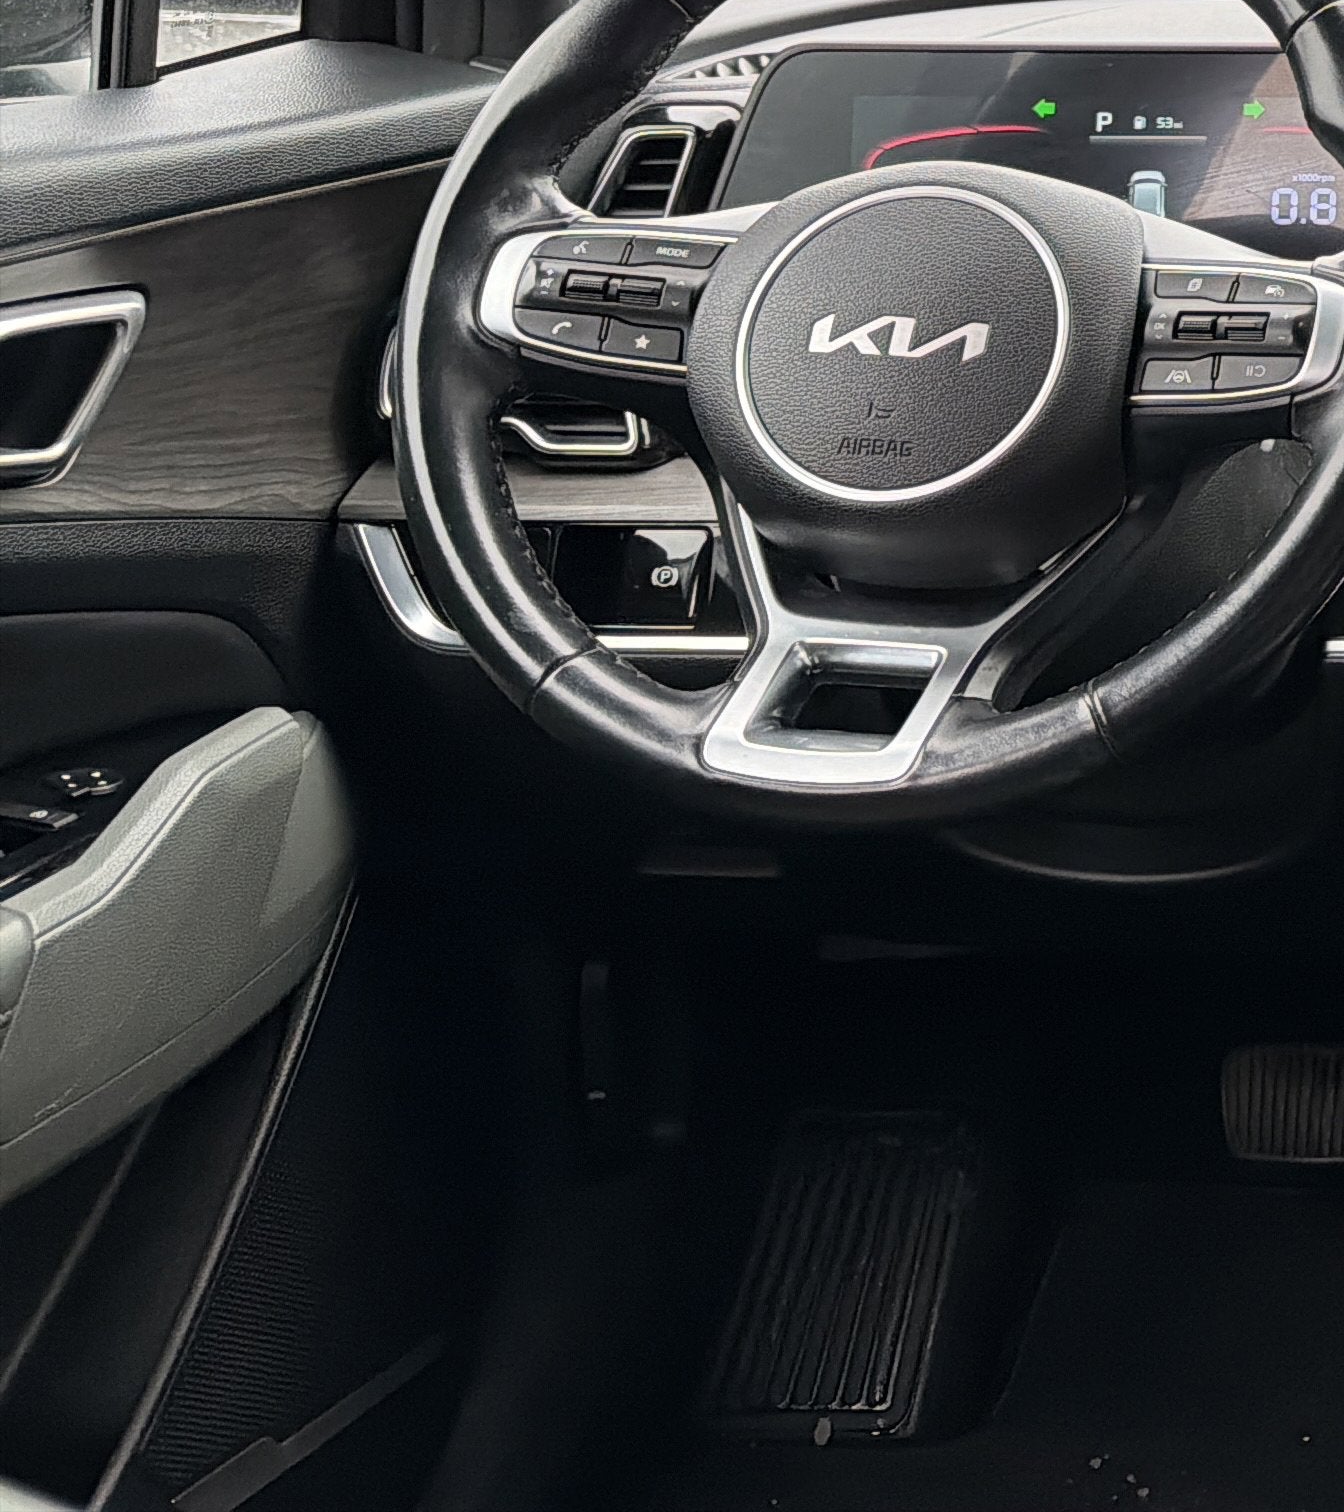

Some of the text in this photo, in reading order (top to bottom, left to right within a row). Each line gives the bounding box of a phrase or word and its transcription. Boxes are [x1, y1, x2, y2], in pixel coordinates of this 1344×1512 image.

[1096, 111, 1113, 133] P
[1271, 187, 1337, 226] 0.8
[655, 245, 691, 258] MODE
[836, 437, 915, 458] AIRBAG
